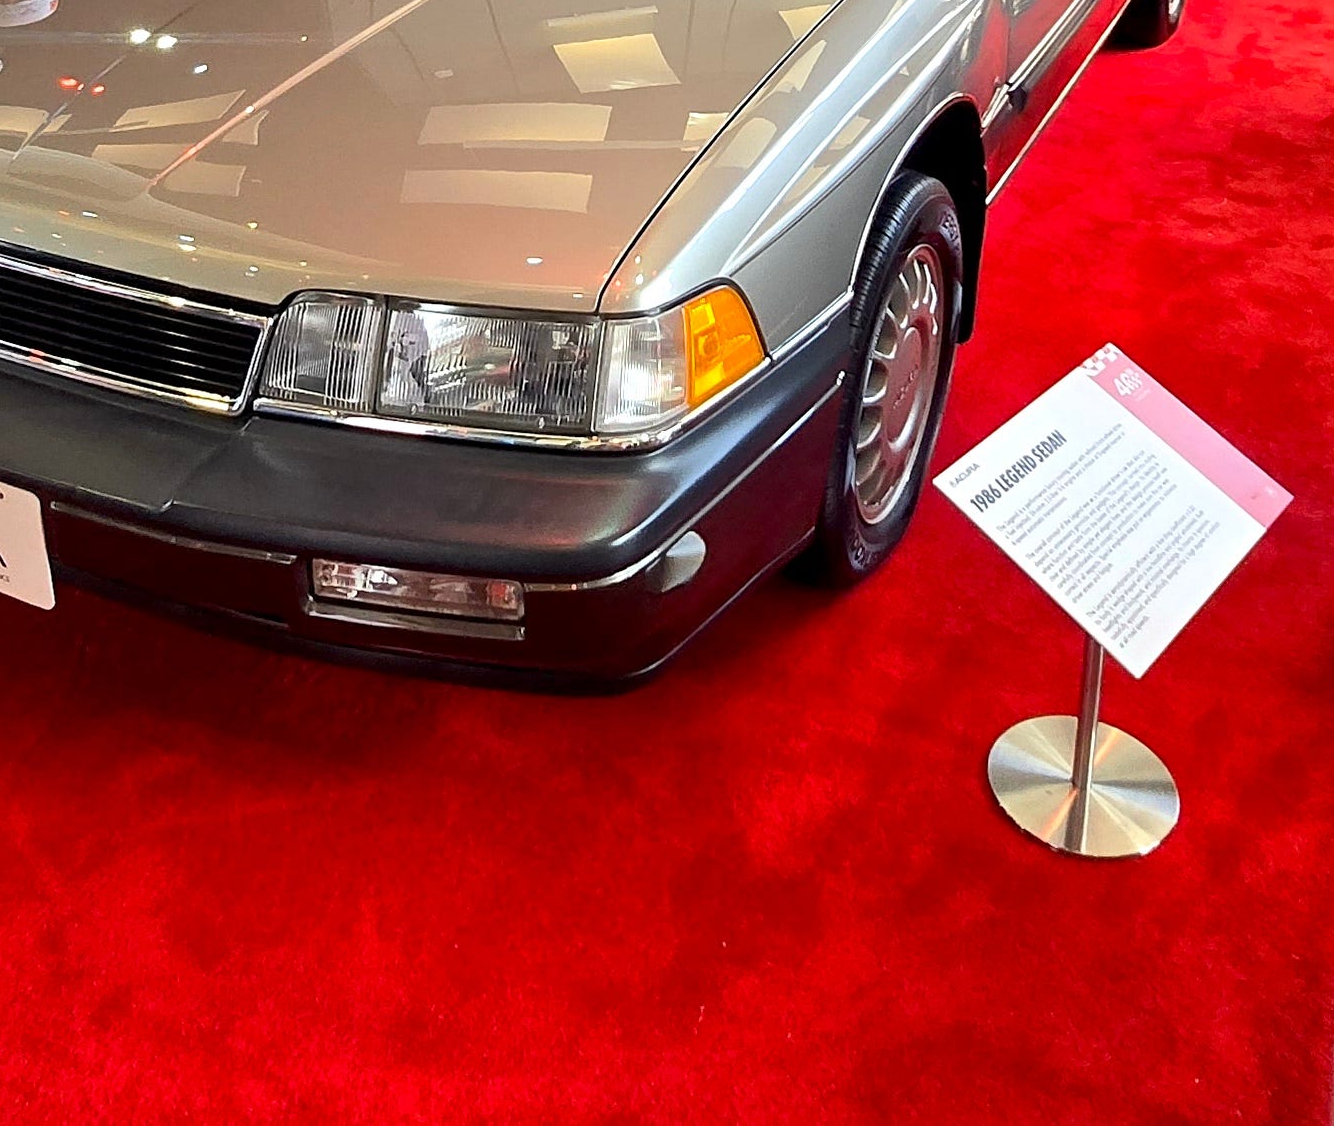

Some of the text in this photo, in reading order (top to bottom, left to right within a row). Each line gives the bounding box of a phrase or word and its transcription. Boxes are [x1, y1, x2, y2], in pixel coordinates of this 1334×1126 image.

[968, 482, 1003, 513] 1986
[993, 452, 1039, 493] LEGEND
[1029, 428, 1068, 462] SEDAN
